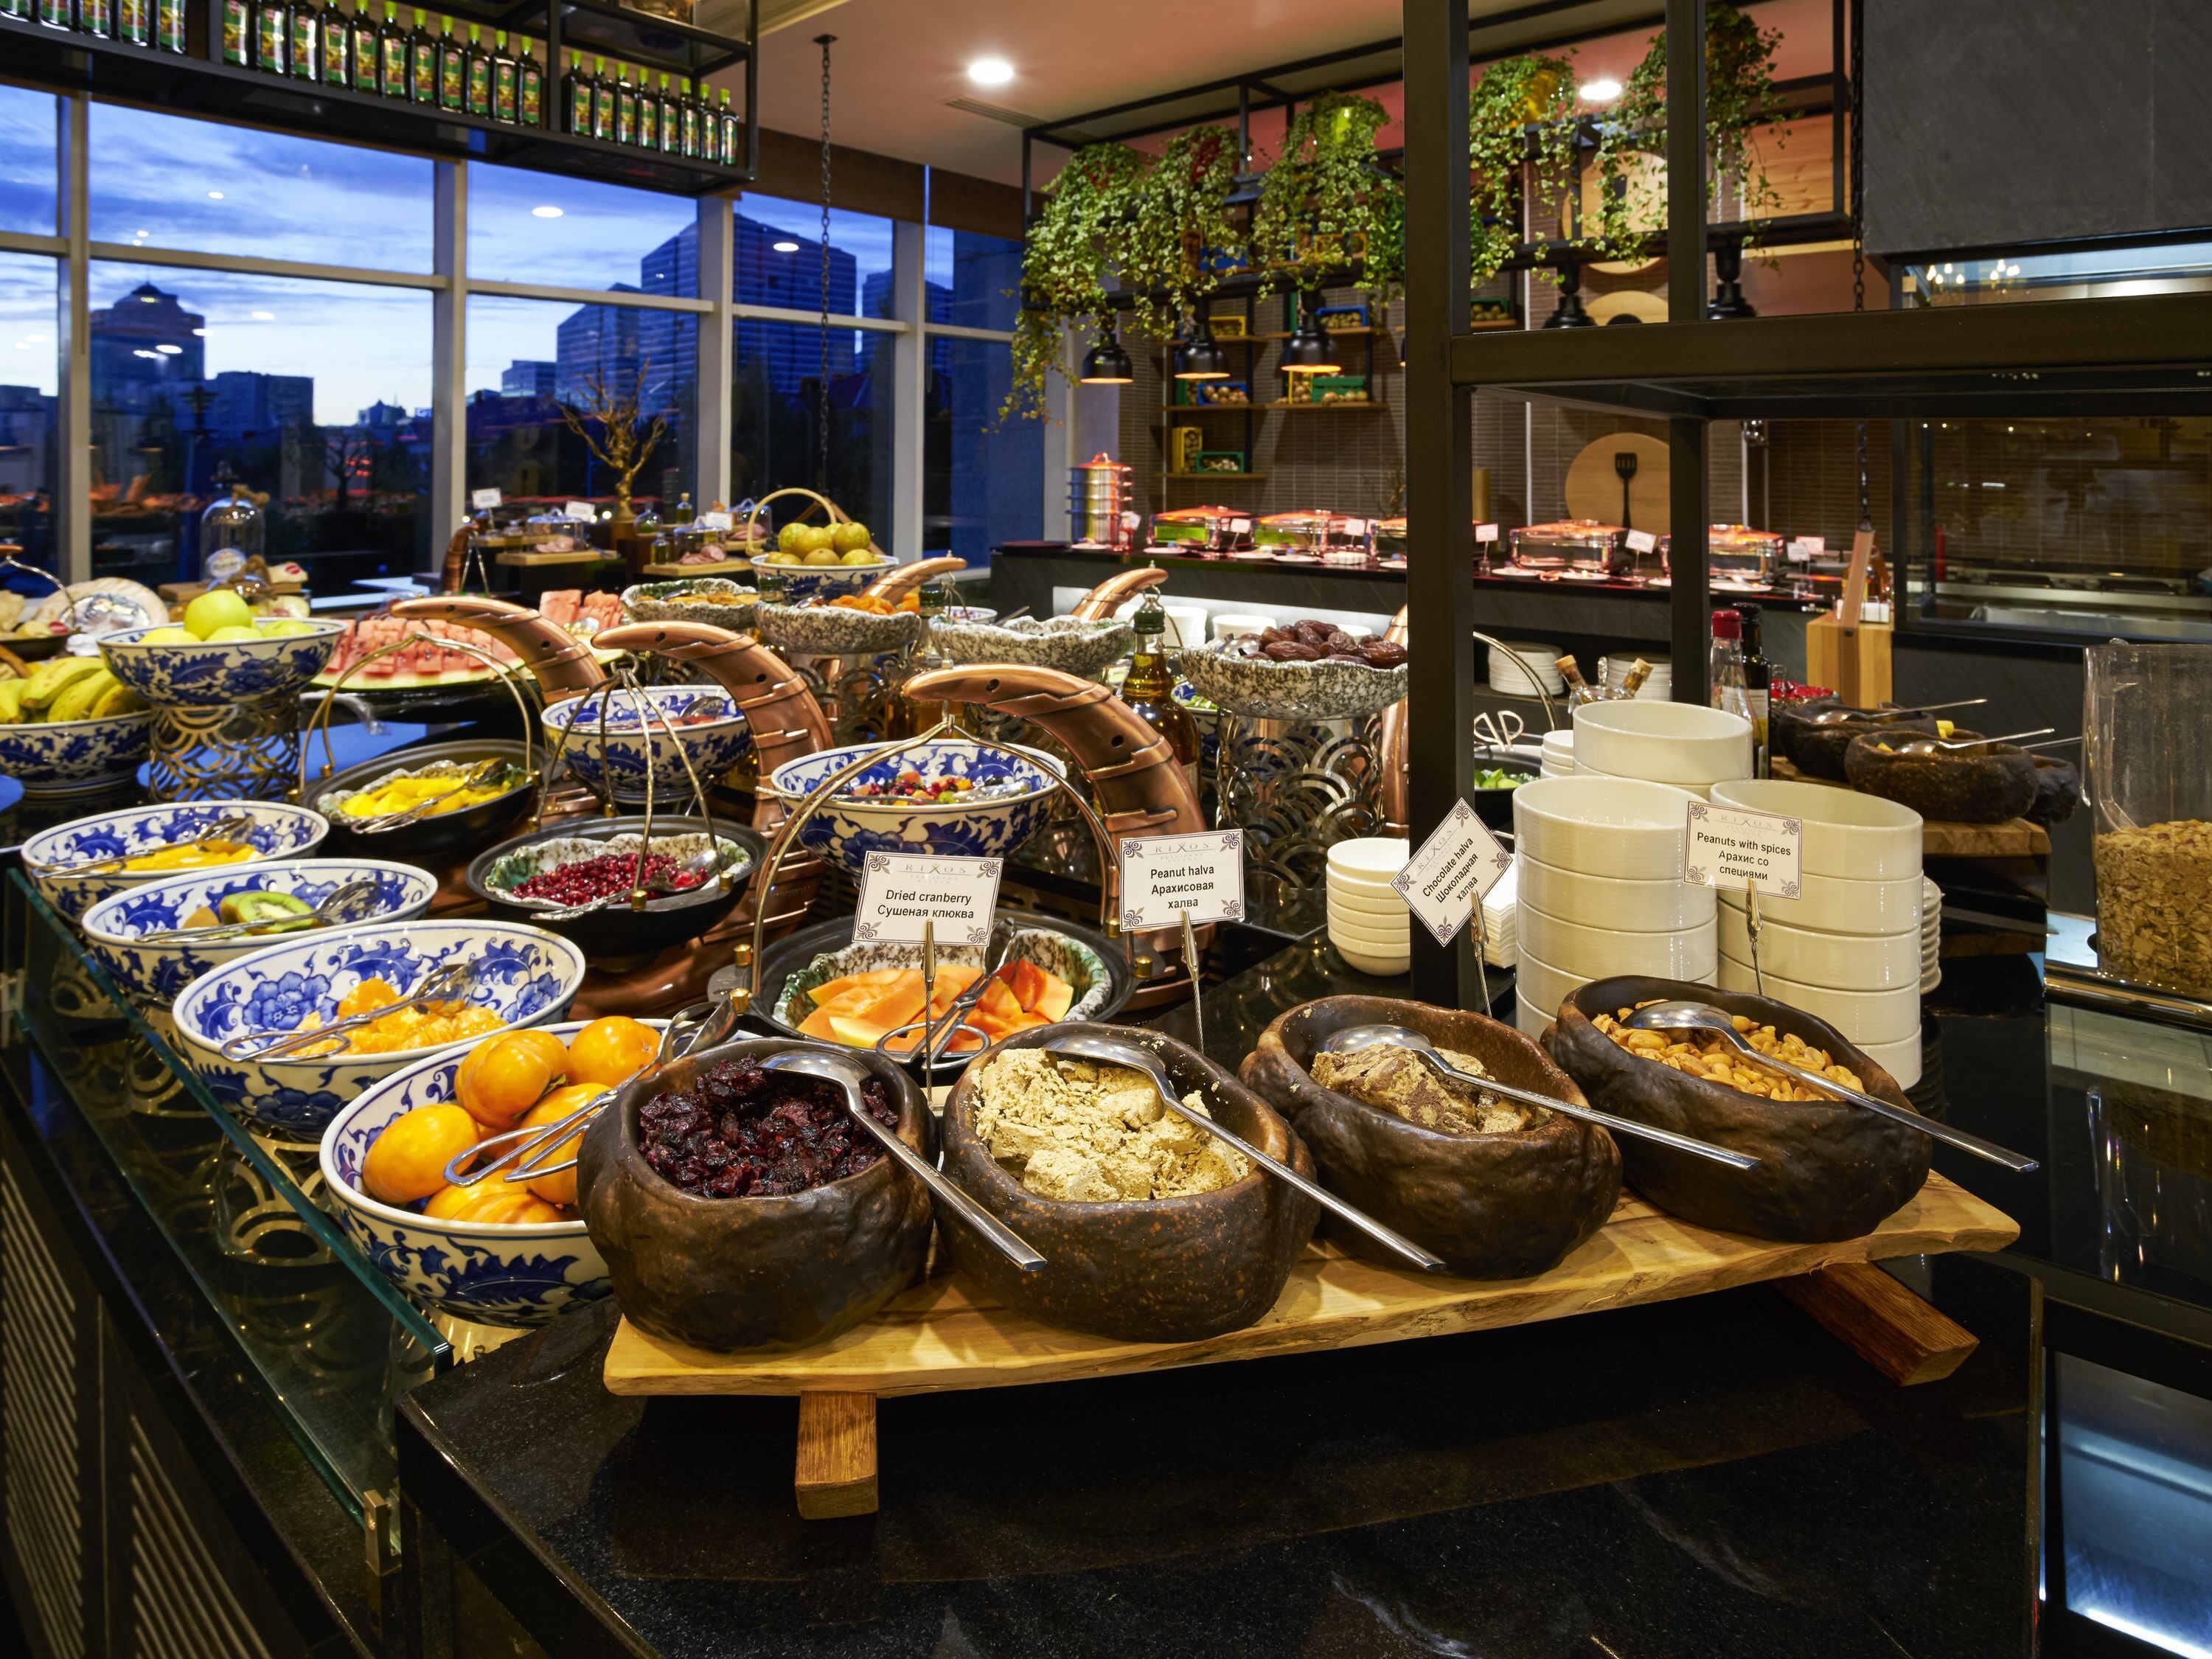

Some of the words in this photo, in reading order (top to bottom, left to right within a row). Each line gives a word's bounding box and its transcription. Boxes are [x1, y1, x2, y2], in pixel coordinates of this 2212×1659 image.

[1155, 842, 1210, 854] RIXOS
[1697, 832, 1736, 846] Peanuts
[1739, 839, 1759, 850] with
[1761, 844, 1791, 856] spices
[1719, 850, 1755, 864] Арахис
[1758, 857, 1769, 866] со
[1150, 867, 1186, 879] Peanut
[1188, 865, 1214, 877] halva
[1422, 856, 1457, 897] Chocolate
[1455, 837, 1473, 861] halva
[1719, 866, 1768, 880] специями
[1435, 852, 1478, 903] Шоколадная
[1151, 882, 1214, 896] Арахисовая
[1456, 875, 1478, 902] халва
[886, 889, 916, 901] Dried
[919, 892, 972, 905] cranberry
[1168, 899, 1198, 909] халва
[877, 905, 928, 918] Сушеная
[932, 910, 974, 919] клюква
